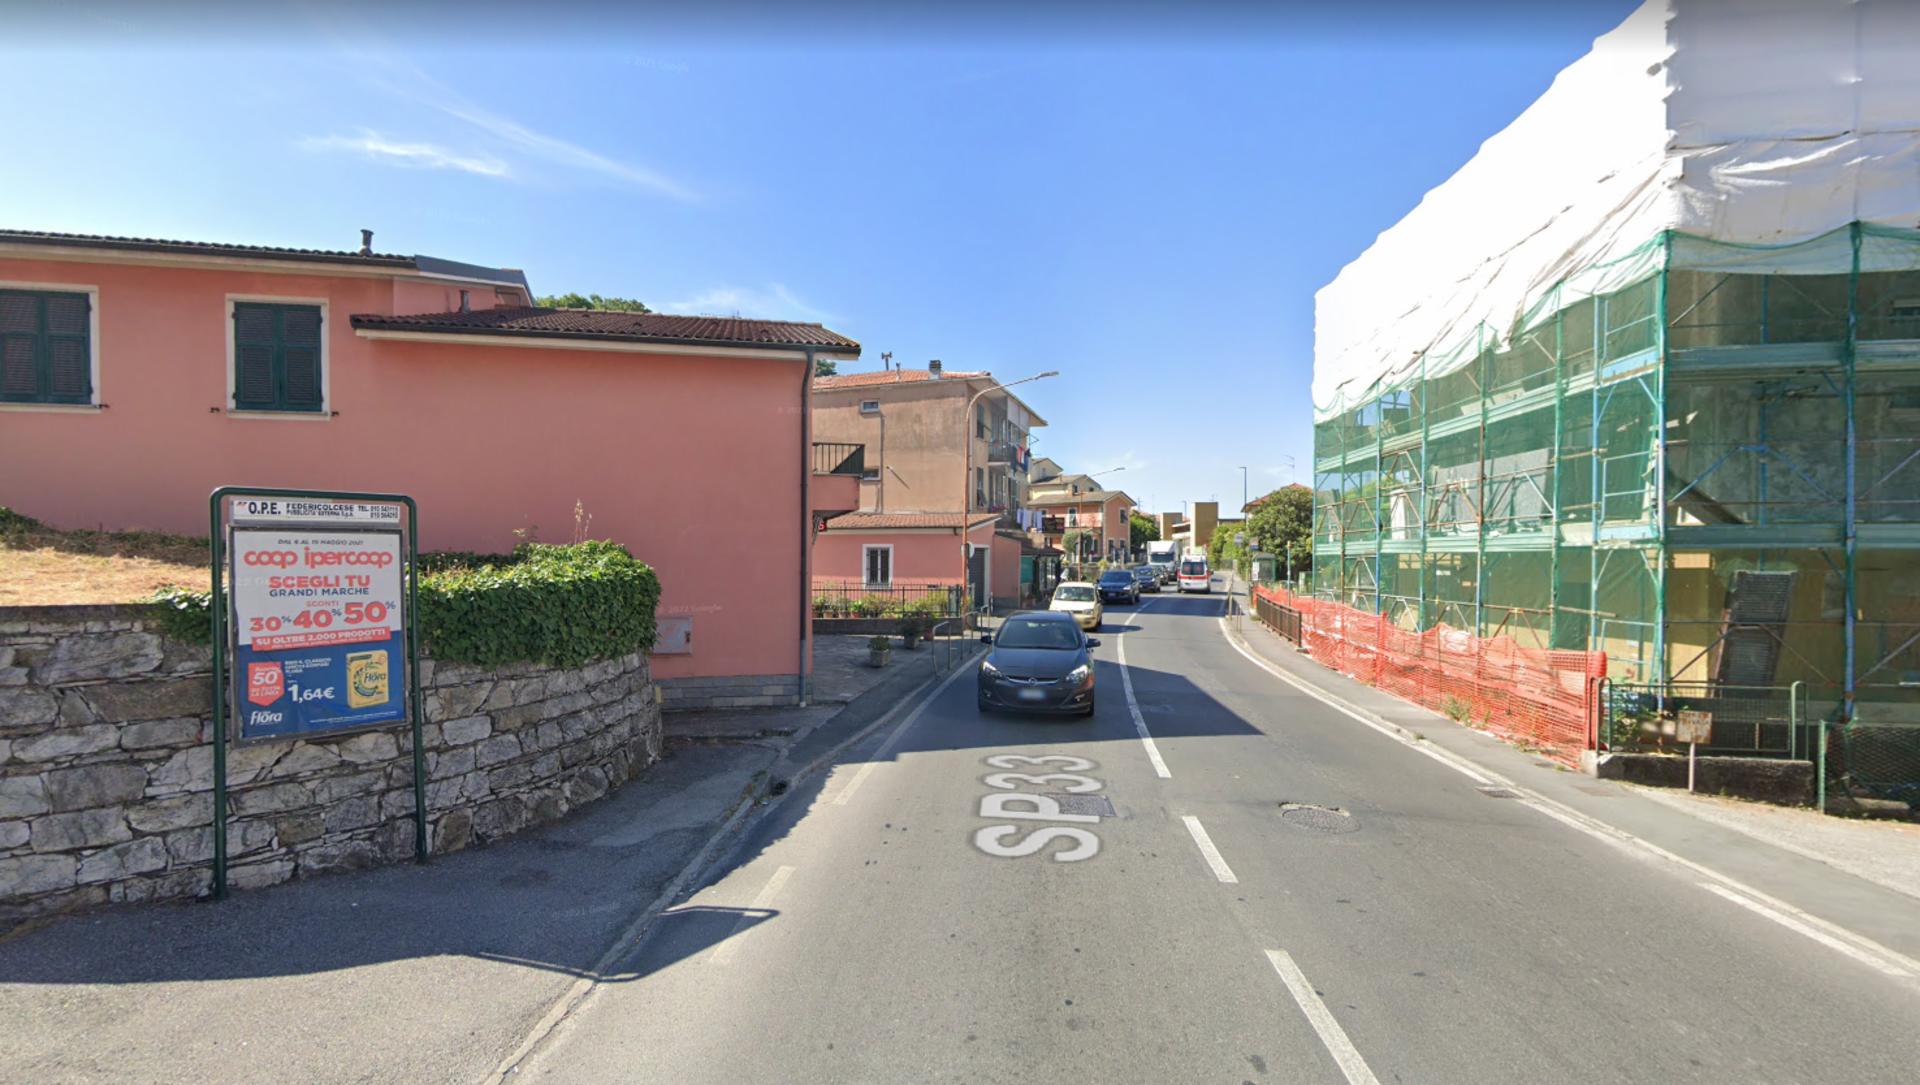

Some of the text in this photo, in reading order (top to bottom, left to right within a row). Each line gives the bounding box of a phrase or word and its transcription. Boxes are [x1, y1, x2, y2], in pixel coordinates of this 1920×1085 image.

[248, 501, 282, 515] O.P.E.
[244, 546, 393, 568] coop ipercoop
[268, 575, 339, 589] SCEGLI
[345, 574, 370, 587] TU
[269, 587, 369, 597] GRANDI MARCHE
[306, 600, 339, 608] SCONTI
[250, 601, 396, 632] 30% 40% 50%
[255, 637, 270, 646] SU
[272, 635, 305, 645] OLTRE
[307, 632, 337, 642] 2.000
[338, 629, 386, 640] PRODOTTI
[287, 684, 335, 703] 1,64€
[975, 754, 1102, 862] SP33
